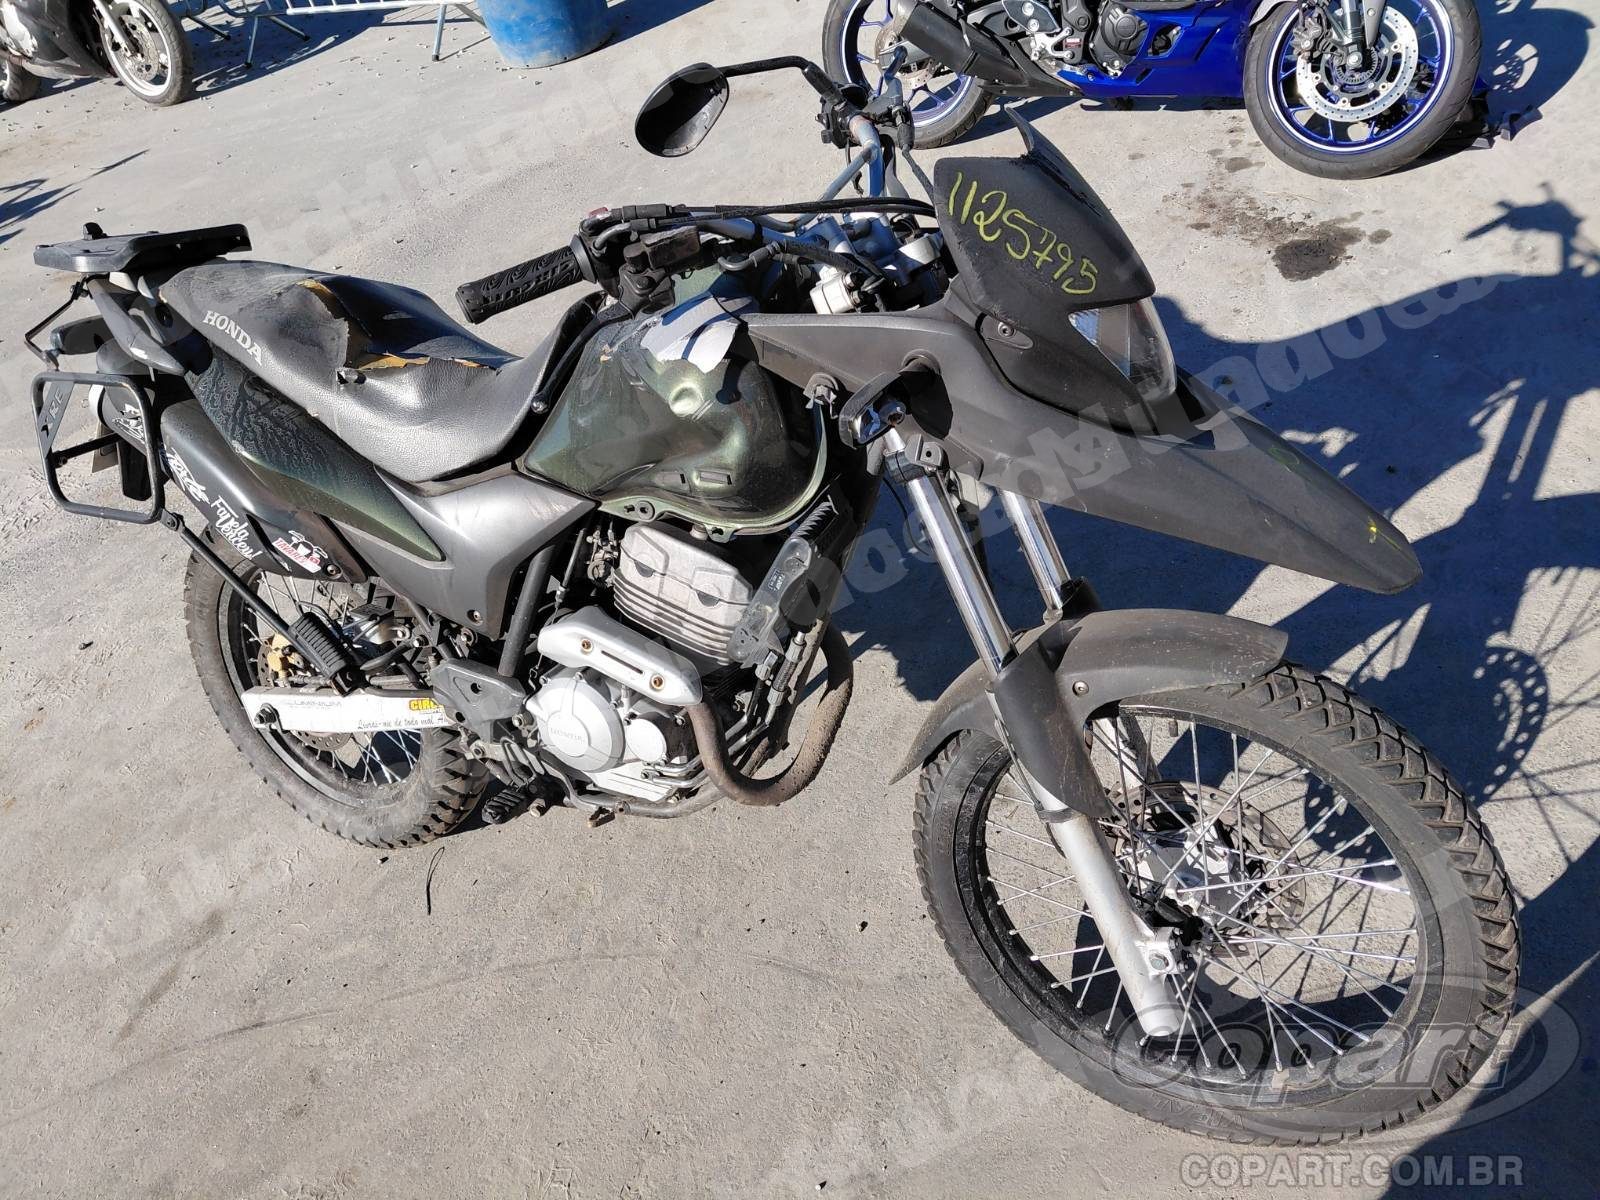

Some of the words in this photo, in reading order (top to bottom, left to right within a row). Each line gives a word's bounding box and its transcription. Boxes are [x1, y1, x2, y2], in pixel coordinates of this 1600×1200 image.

[948, 171, 1099, 295] 1125795
[202, 310, 263, 366] HONDA
[211, 495, 250, 538] Favela
